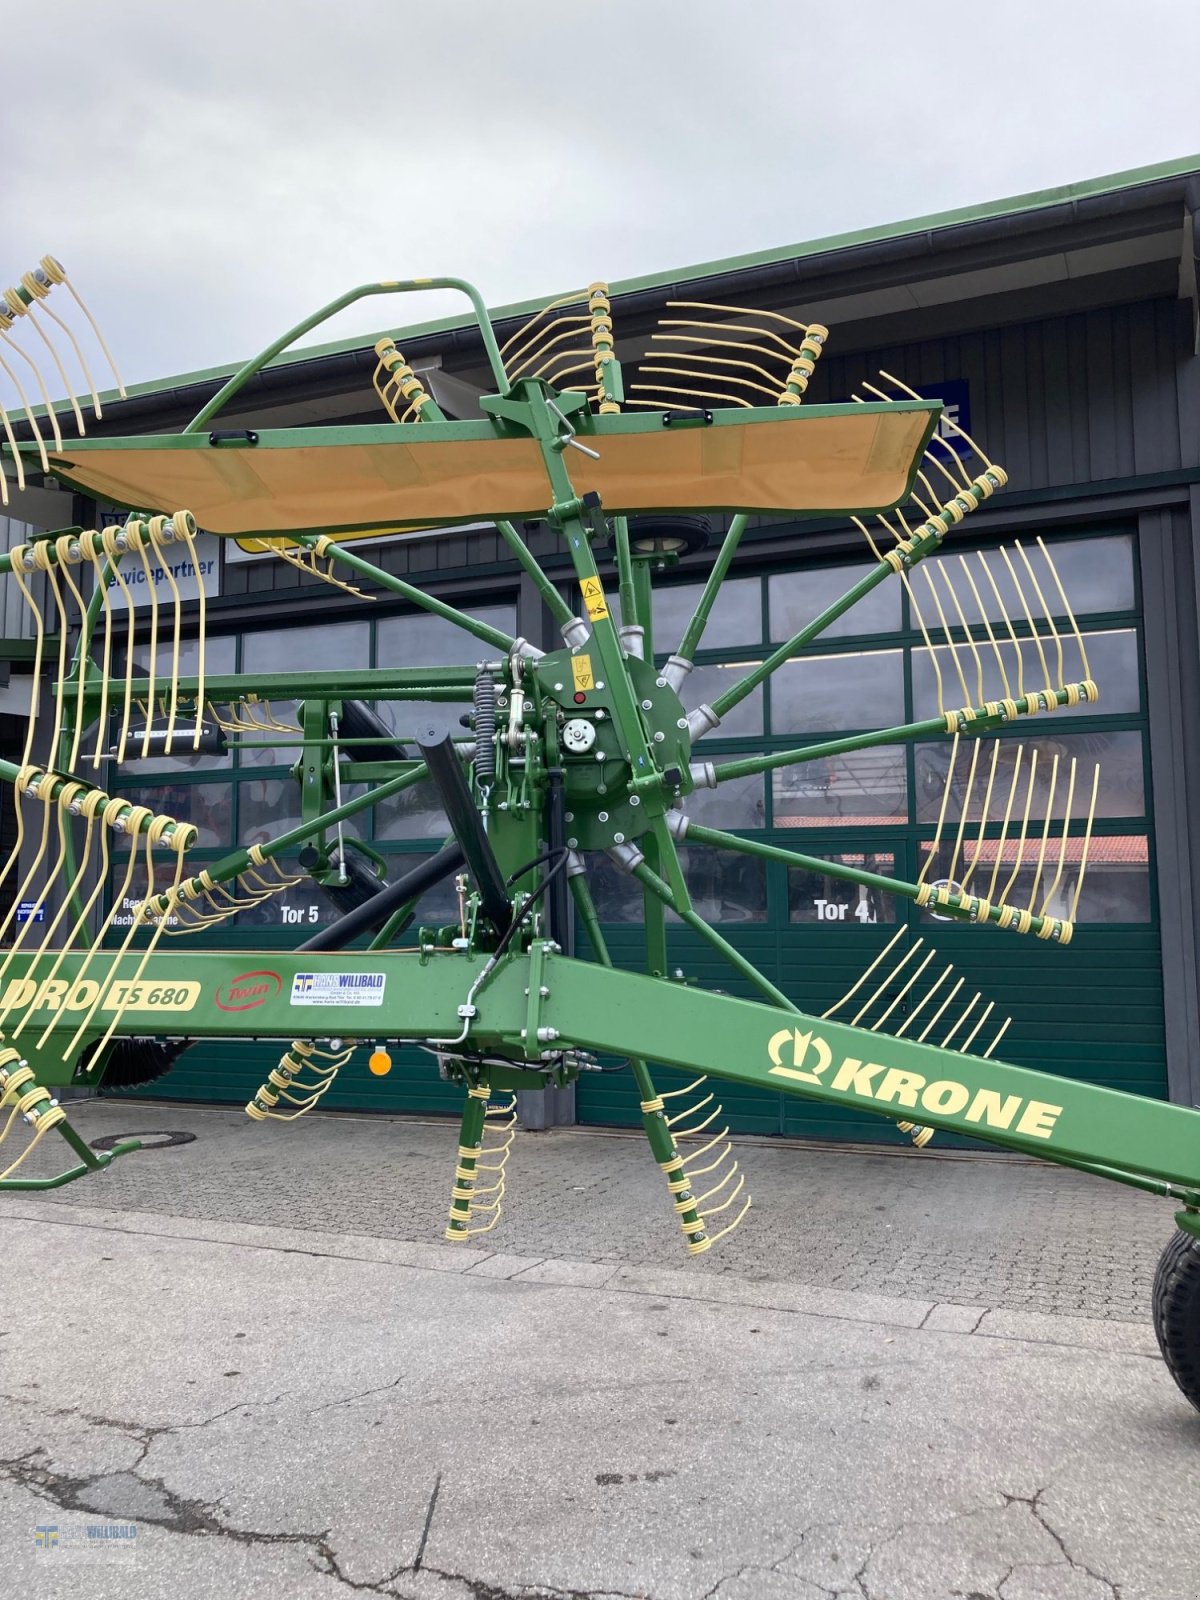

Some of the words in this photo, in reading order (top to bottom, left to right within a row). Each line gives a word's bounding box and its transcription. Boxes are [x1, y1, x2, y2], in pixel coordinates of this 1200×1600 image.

[109, 560, 214, 588] ervicepartner
[280, 905, 304, 923] Tor
[308, 905, 319, 923] 5
[813, 899, 848, 920] Tor
[855, 900, 869, 921] 4
[339, 975, 383, 988] WILLIBALD
[117, 987, 141, 1005] TS
[147, 987, 189, 1005] 680
[228, 984, 269, 1001] Twin
[830, 1057, 1064, 1139] KRONE
